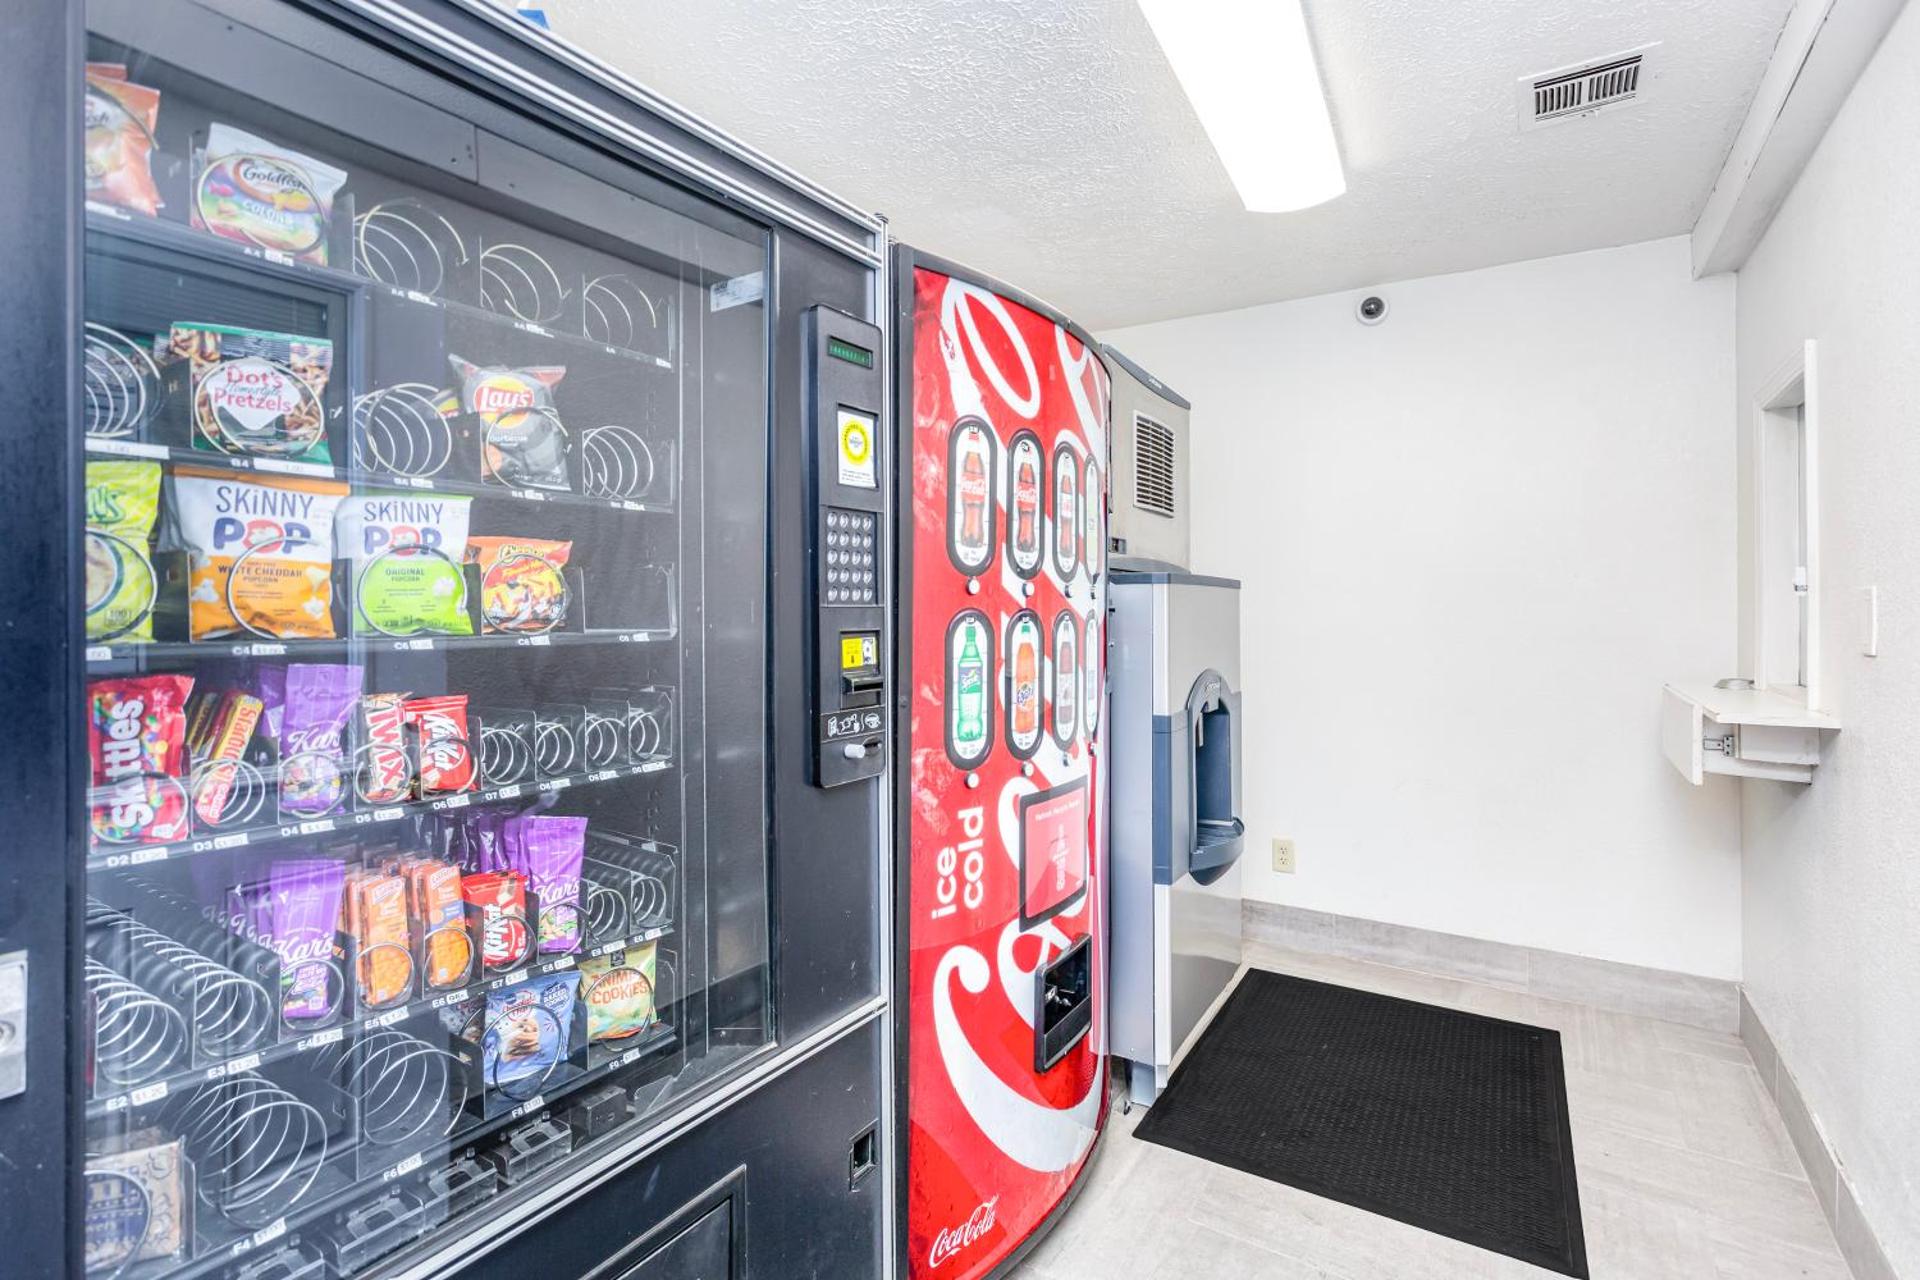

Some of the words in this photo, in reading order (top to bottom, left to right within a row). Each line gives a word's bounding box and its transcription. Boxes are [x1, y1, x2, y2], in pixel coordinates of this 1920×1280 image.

[227, 365, 284, 389] Dot's
[214, 387, 292, 412] Pretzels
[213, 517, 311, 554] POP
[364, 525, 442, 556] POP
[433, 801, 446, 810] D6
[281, 826, 298, 837] D4
[193, 841, 212, 852] D3
[107, 855, 129, 868] D2
[957, 806, 985, 909] cold
[931, 847, 957, 919] ice
[492, 979, 504, 989] E7
[592, 980, 648, 1005] COOKIES
[432, 998, 446, 1008] E6
[298, 1039, 313, 1051] E4
[208, 1066, 226, 1080] E3
[106, 1095, 128, 1111] E2
[384, 1168, 397, 1181] F6
[929, 1193, 999, 1268] Coca-Cola
[233, 1239, 250, 1255] F4
